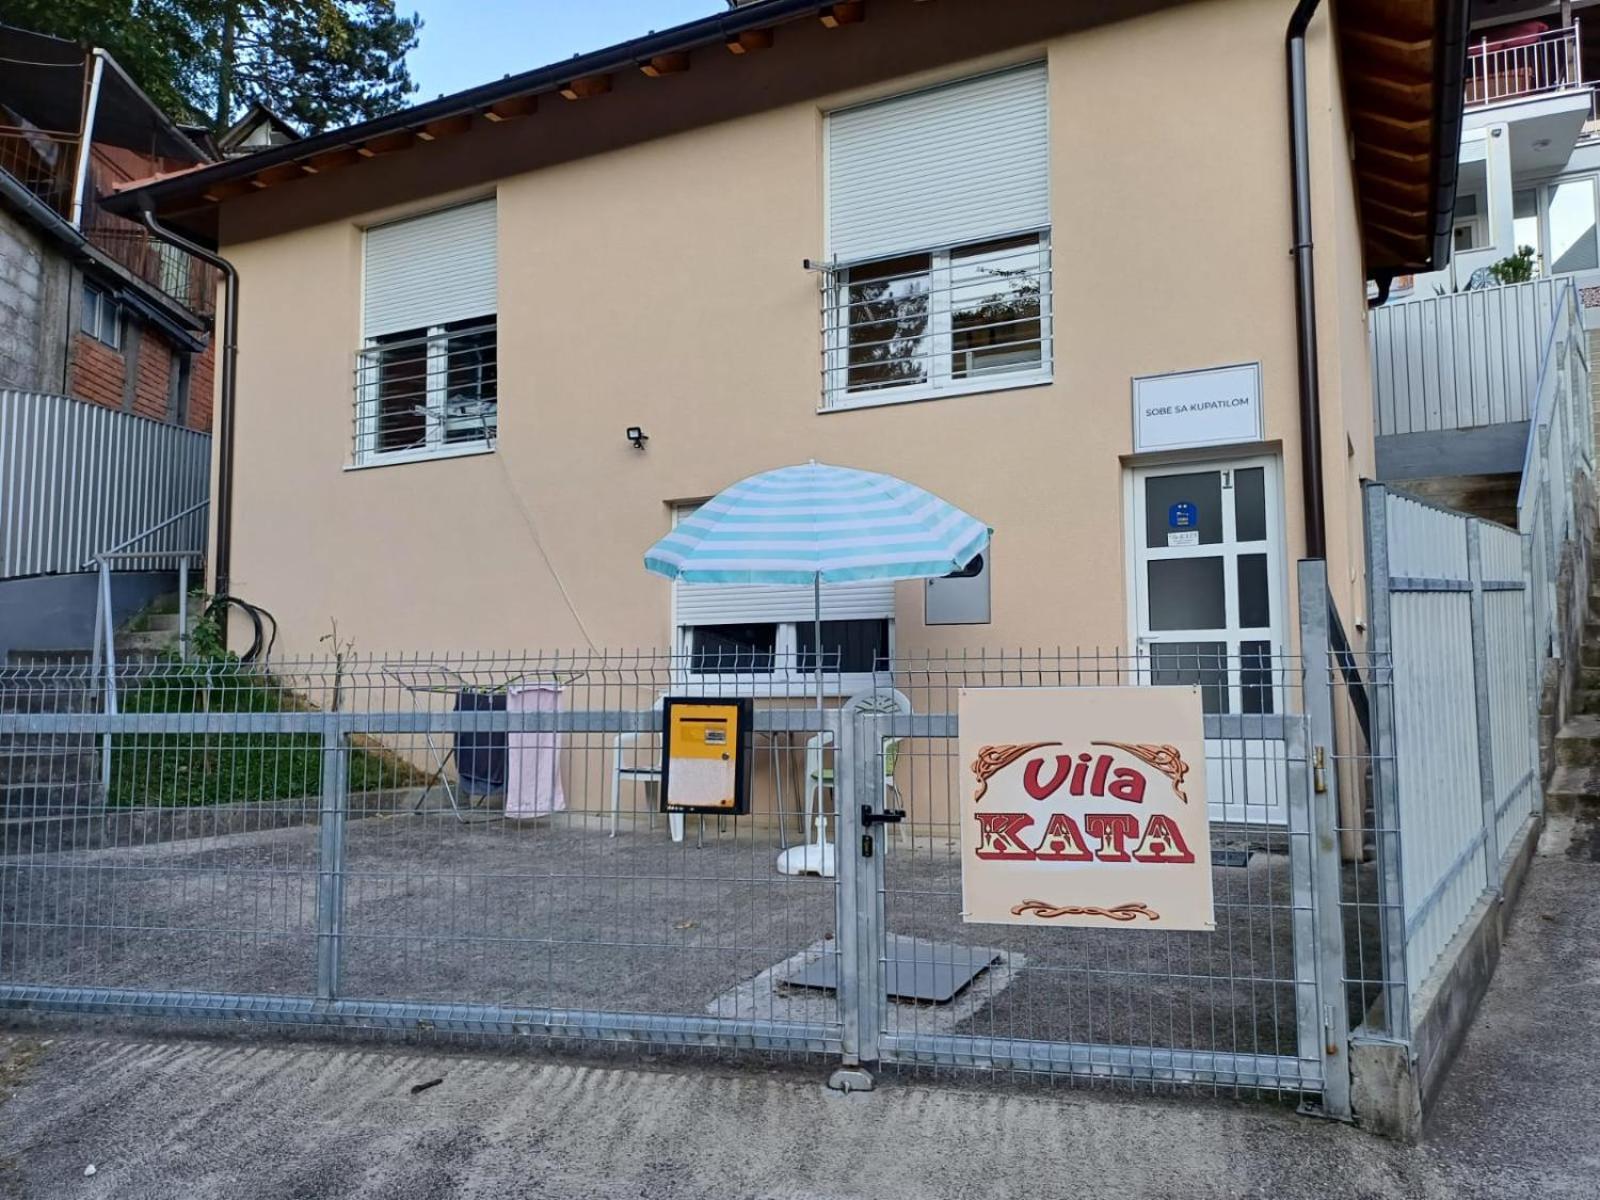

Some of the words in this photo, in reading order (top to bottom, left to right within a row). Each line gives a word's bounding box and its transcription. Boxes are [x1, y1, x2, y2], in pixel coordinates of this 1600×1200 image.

[1145, 406, 1172, 417] SOBE
[1175, 404, 1188, 414] SA
[1190, 397, 1249, 411] KUPATILOM
[1222, 471, 1233, 489] 1
[1023, 752, 1147, 804] Vila
[974, 812, 1195, 864] KATA
